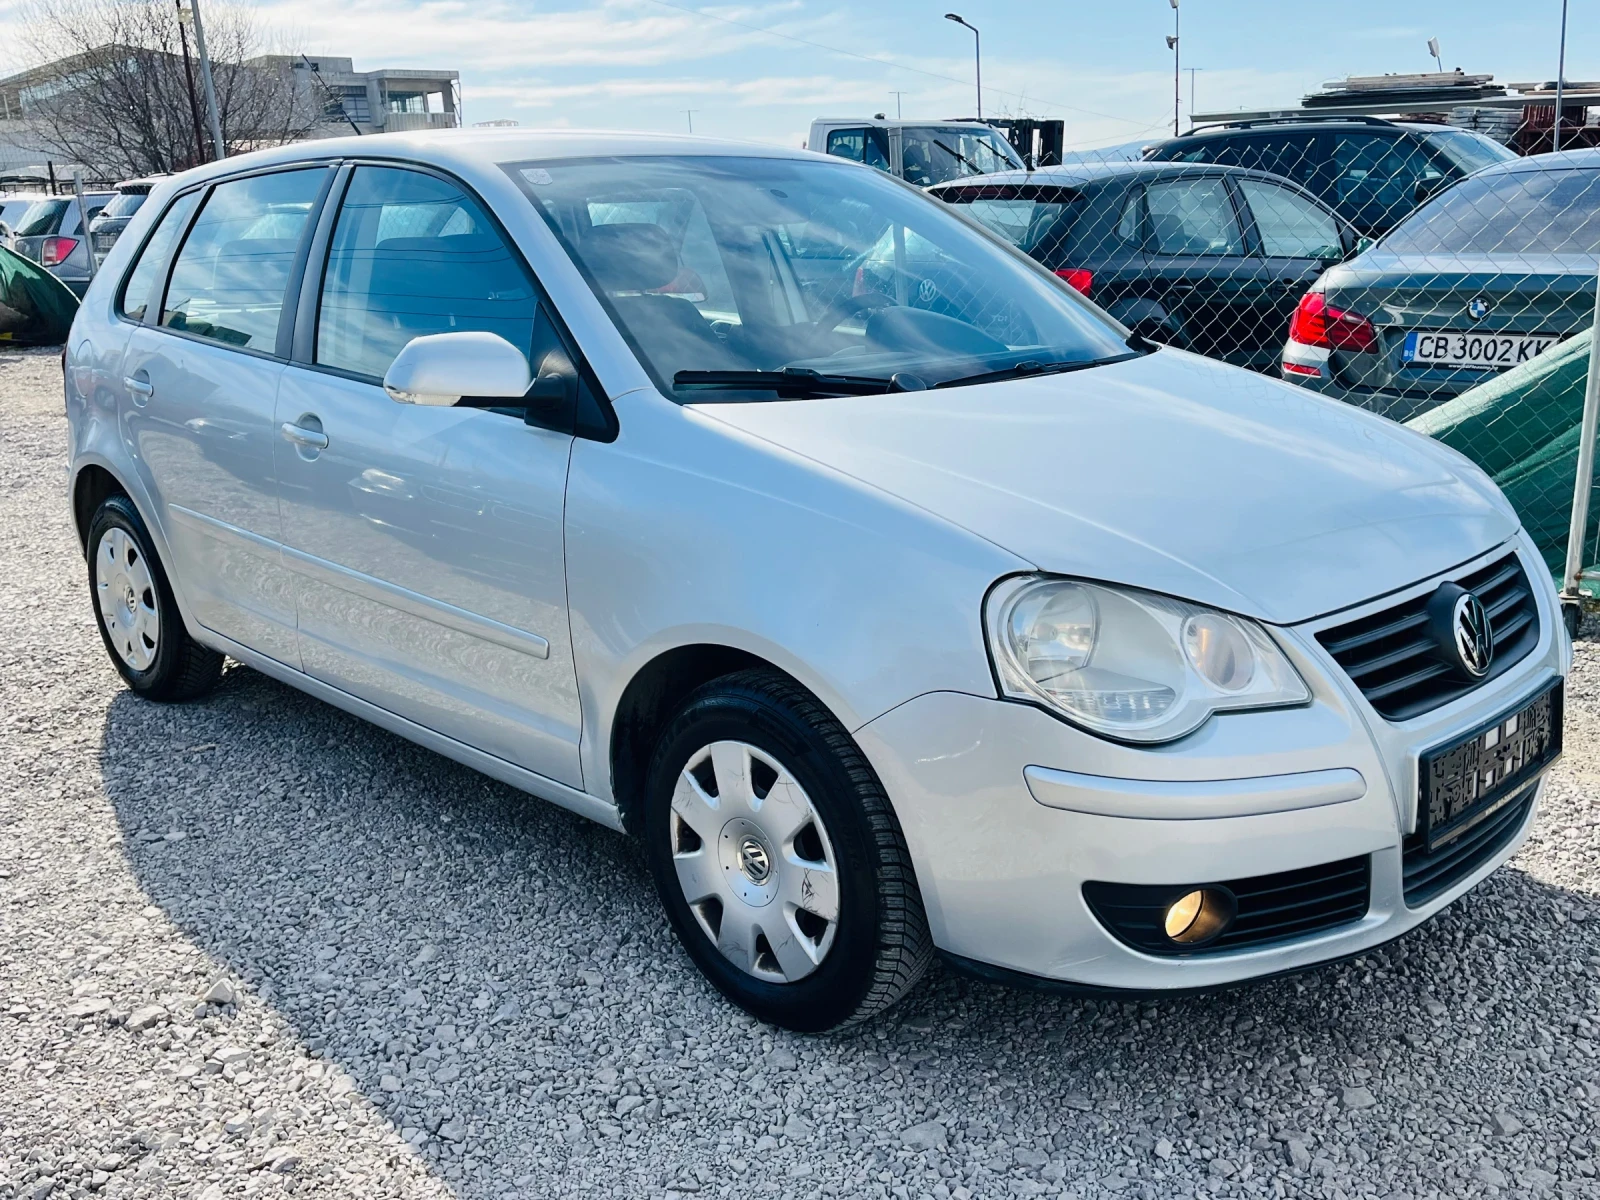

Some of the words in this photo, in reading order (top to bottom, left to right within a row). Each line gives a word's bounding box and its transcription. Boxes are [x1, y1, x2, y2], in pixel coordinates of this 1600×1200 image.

[919, 279, 936, 302] VW
[1403, 349, 1414, 358] BG
[1418, 336, 1449, 360] CB
[1453, 337, 1514, 363] 3002
[1453, 593, 1494, 677] VW
